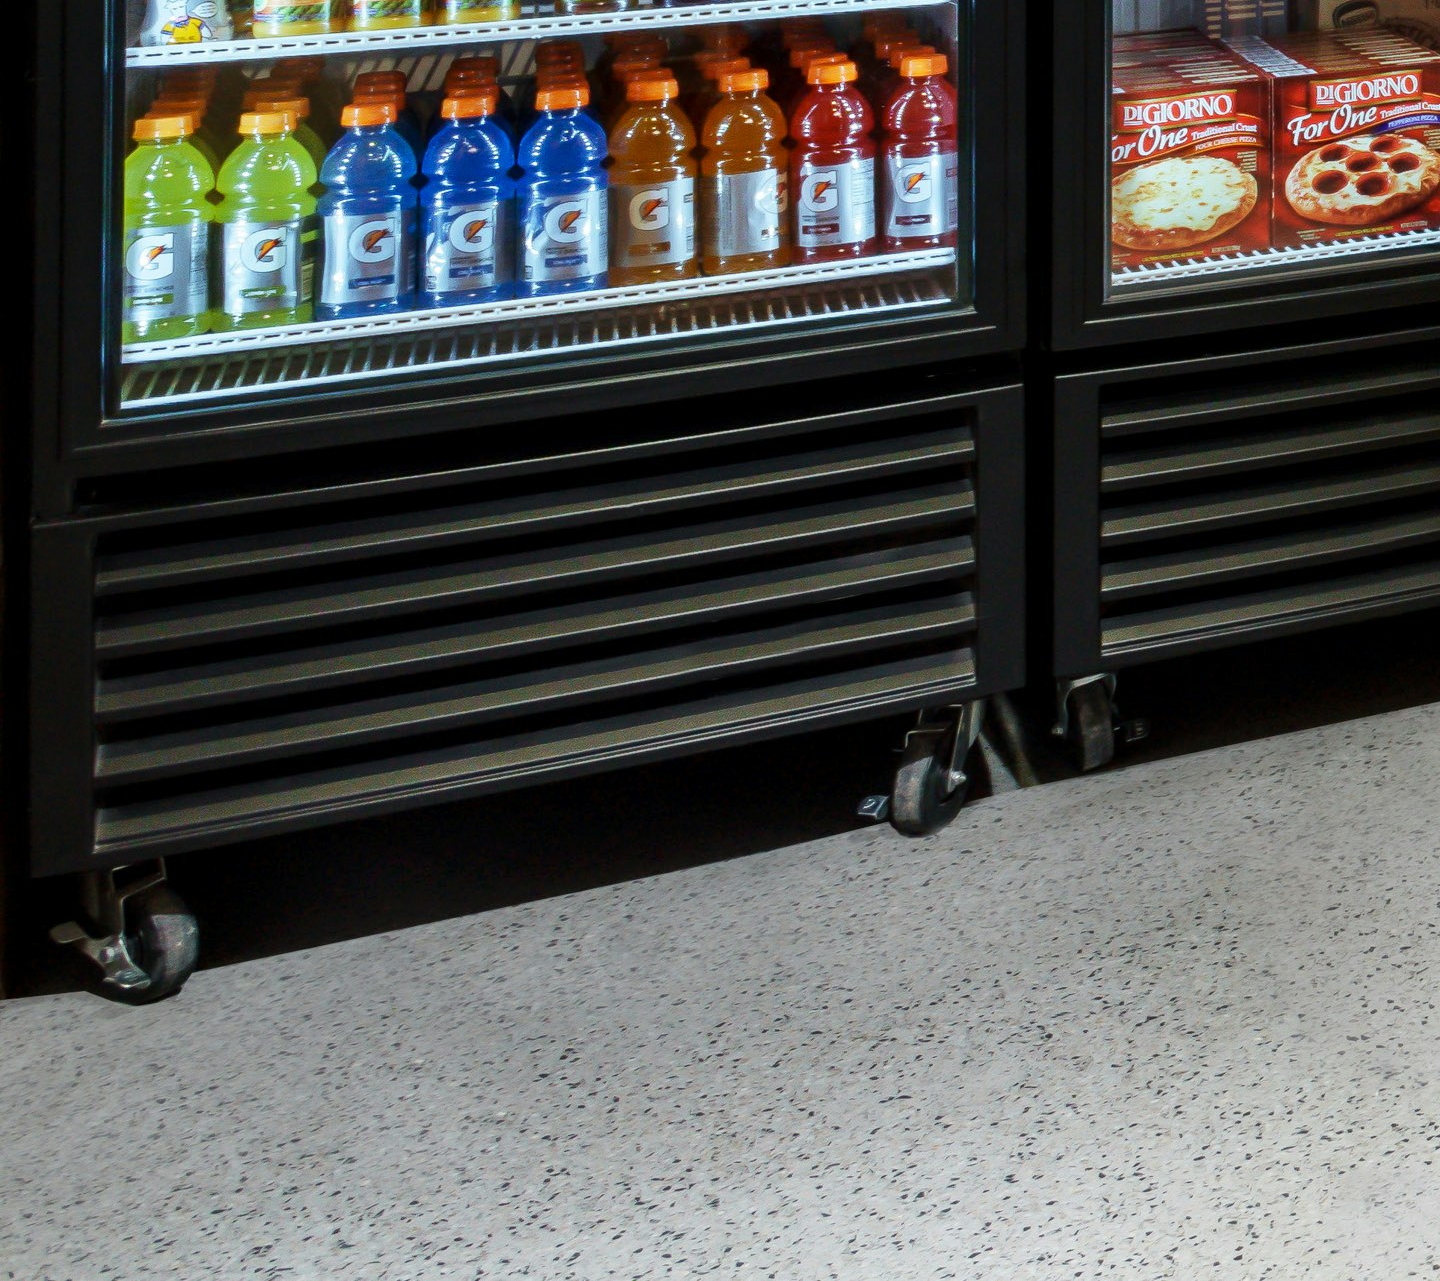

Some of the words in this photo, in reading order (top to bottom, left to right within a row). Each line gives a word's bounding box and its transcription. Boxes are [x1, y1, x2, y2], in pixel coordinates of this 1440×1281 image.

[1287, 112, 1329, 146] For
[1328, 103, 1377, 133] One
[1379, 106, 1421, 119] Traditional
